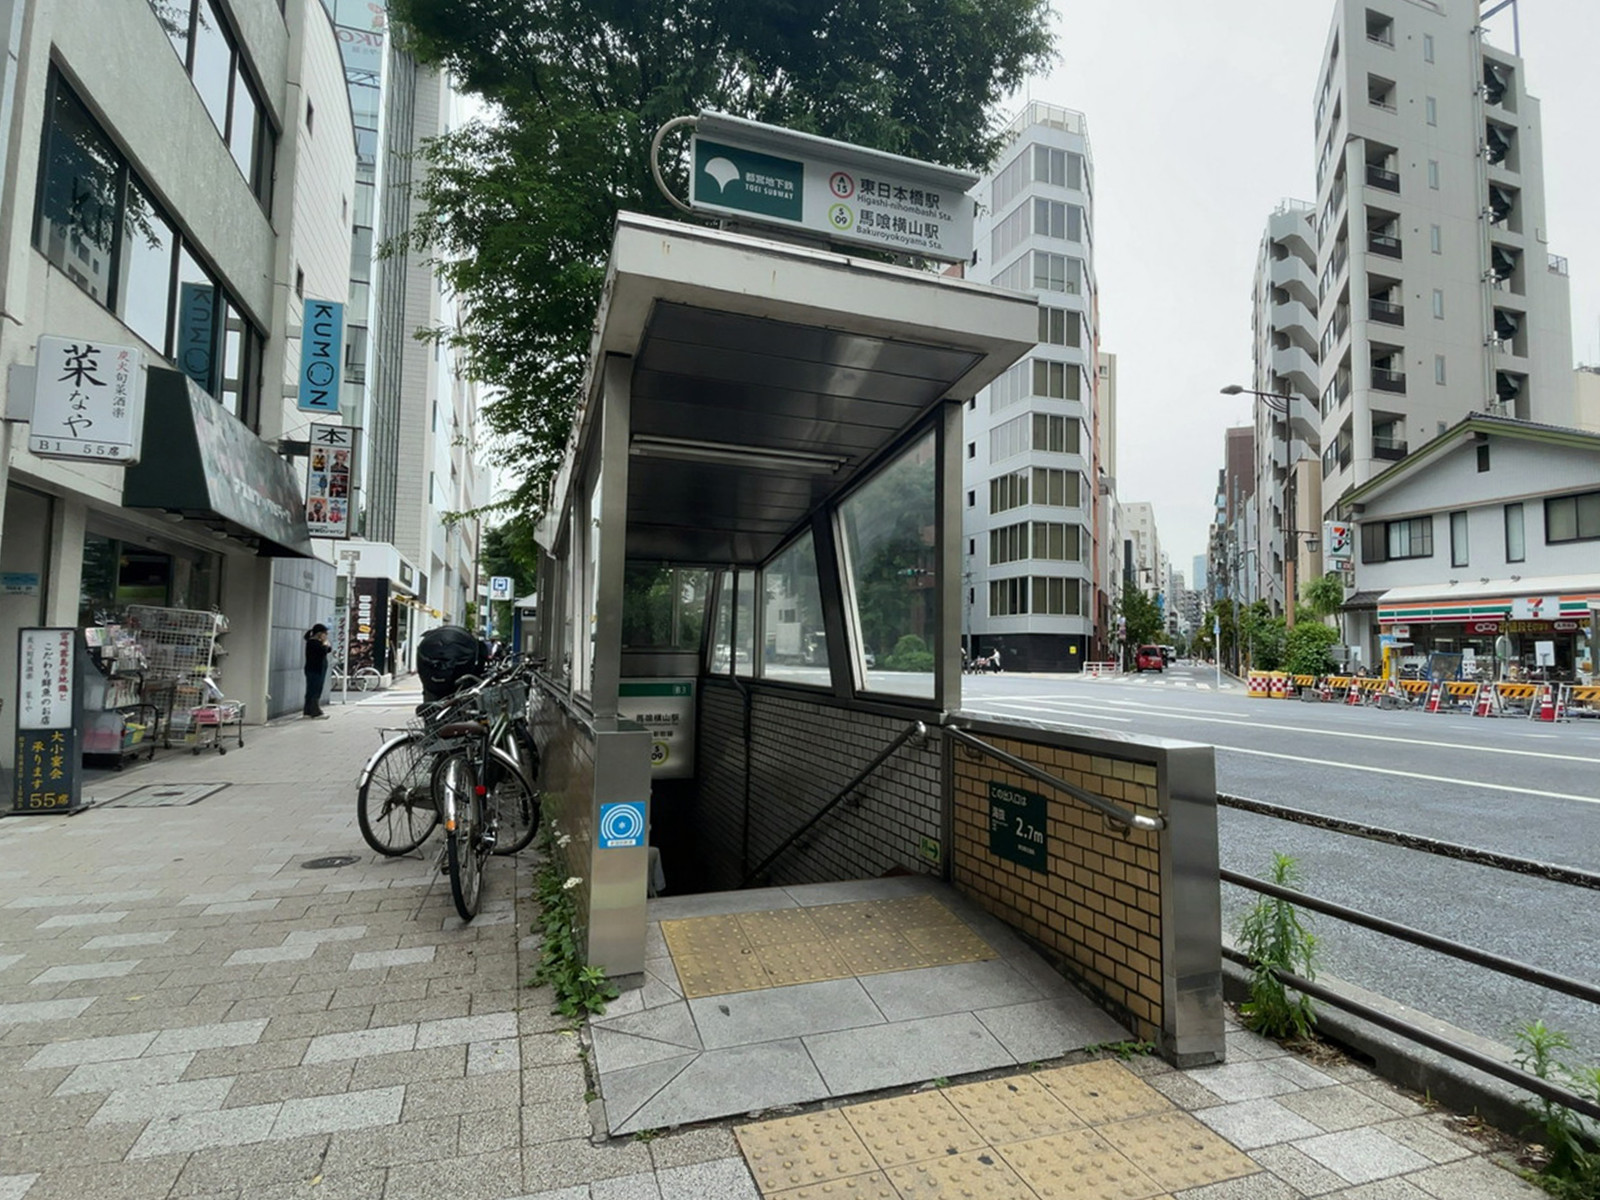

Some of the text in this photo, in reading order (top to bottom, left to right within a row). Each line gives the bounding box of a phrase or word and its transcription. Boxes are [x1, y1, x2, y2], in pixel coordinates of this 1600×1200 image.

[745, 183, 794, 200] TOEI SUBWAY
[836, 184, 848, 194] 15
[838, 176, 846, 185] A
[859, 178, 940, 209] 東日本橋駅
[834, 215, 848, 225] 09
[838, 207, 845, 216] S
[857, 194, 955, 222] Higashi-nihombashi Sta.
[859, 208, 940, 239] 馬喰横山駅
[856, 225, 944, 250] Bakuroyokoyama Sta.
[306, 304, 335, 406] KUMON
[57, 344, 108, 438] 菜なや
[39, 440, 119, 457] B1 55席
[317, 428, 347, 447] 本
[31, 741, 46, 790] 承ります
[50, 731, 65, 780] 大小宴会
[1015, 816, 1044, 845] 2.7m
